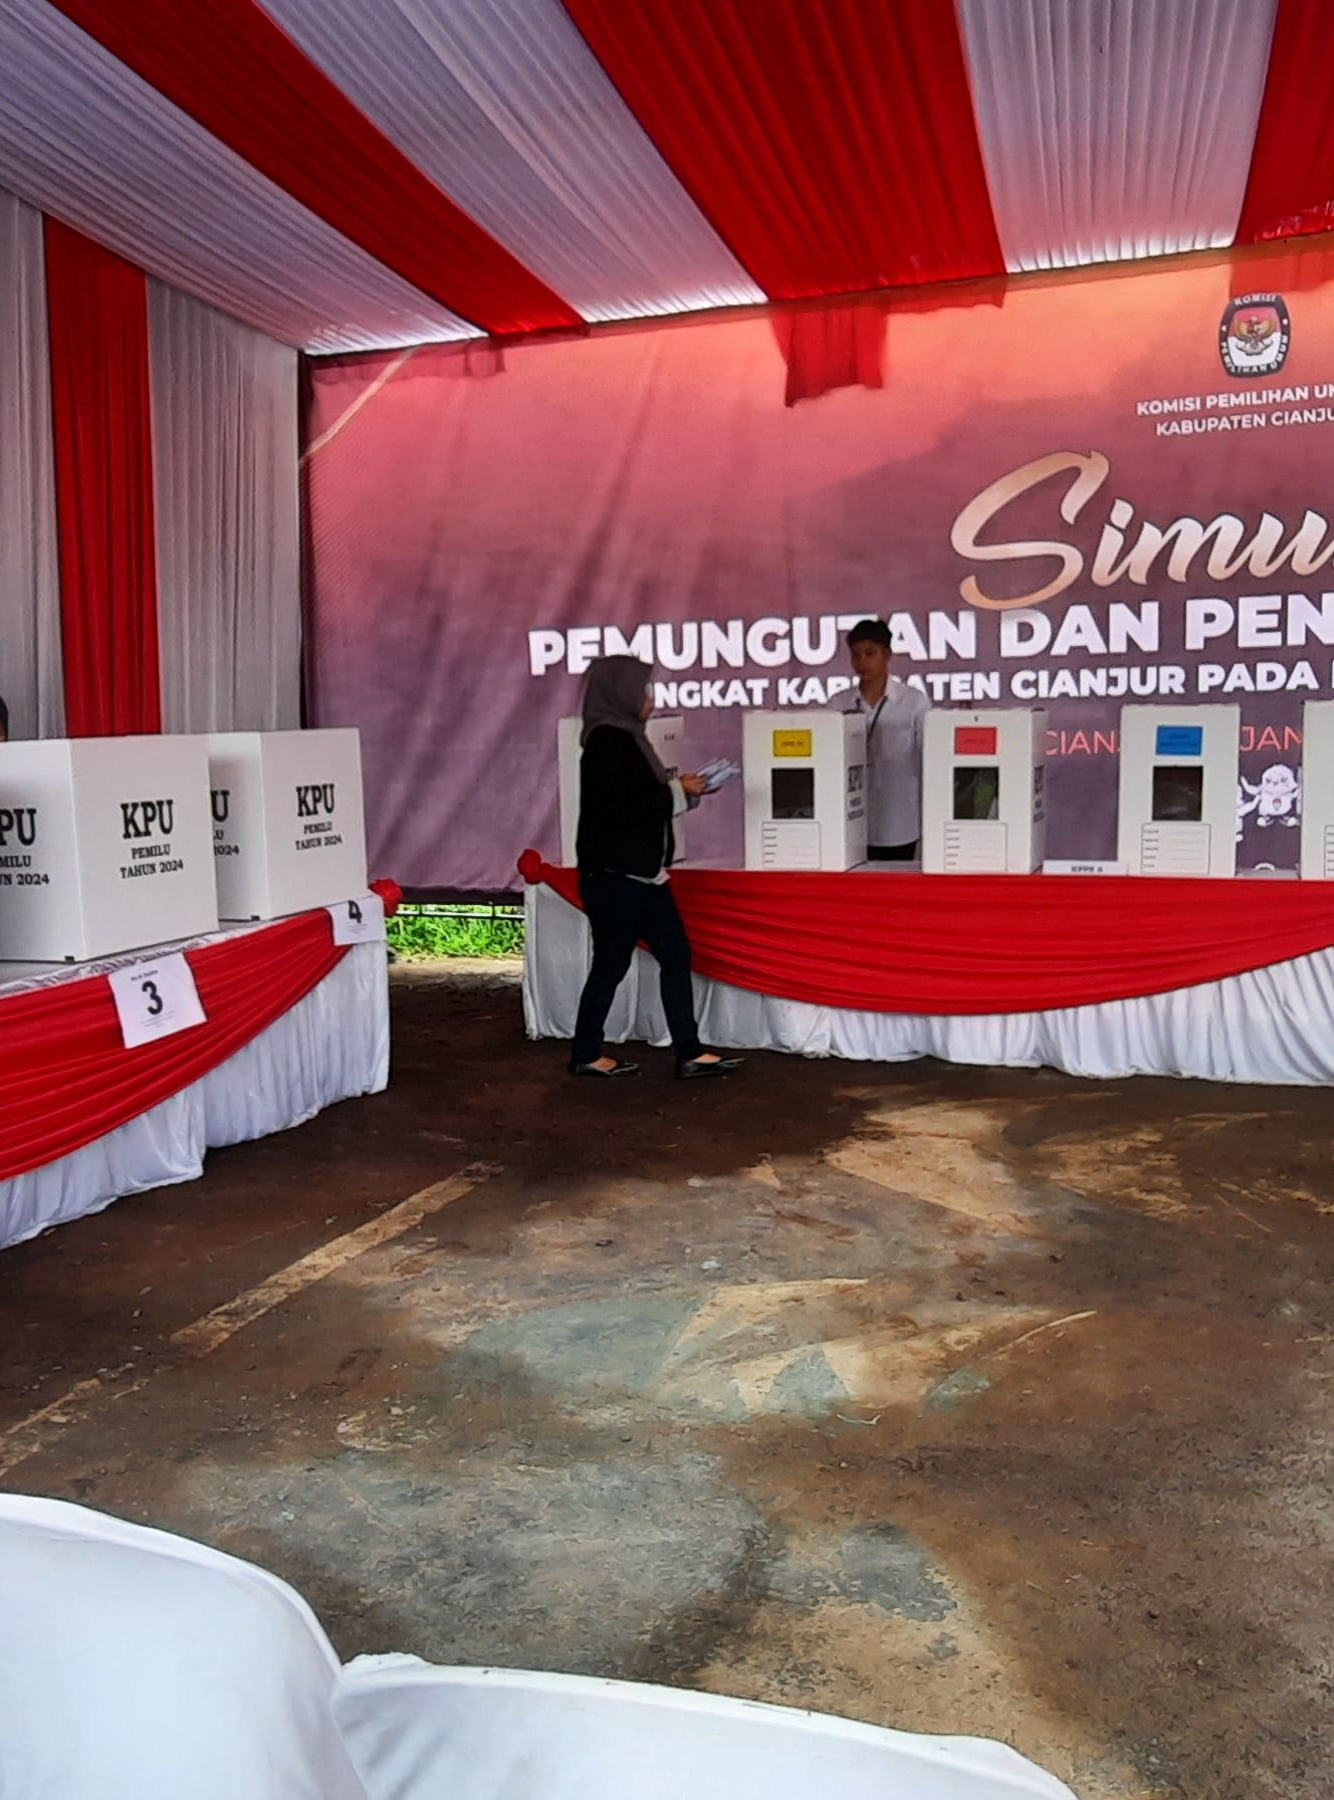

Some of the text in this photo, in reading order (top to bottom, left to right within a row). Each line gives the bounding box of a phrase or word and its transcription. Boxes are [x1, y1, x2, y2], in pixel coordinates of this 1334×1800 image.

[1137, 400, 1201, 416] KOMISI
[1205, 385, 1309, 409] PEMILIHAN
[1156, 413, 1266, 436] KABUPATEN
[999, 602, 1159, 658] DAN
[653, 677, 770, 709] NGKAT
[1010, 664, 1186, 699] CIANJUR
[1198, 661, 1319, 693] PADA
[296, 783, 335, 817] KPU
[121, 799, 174, 839] KPU
[303, 822, 333, 835] PEMILU
[131, 844, 171, 859] PEMILU
[295, 834, 343, 850] TAHUN 2024
[17, 873, 50, 886] 2024
[120, 859, 184, 879] TAHUN 2024
[347, 900, 363, 924] 4
[141, 980, 164, 1015] 3
